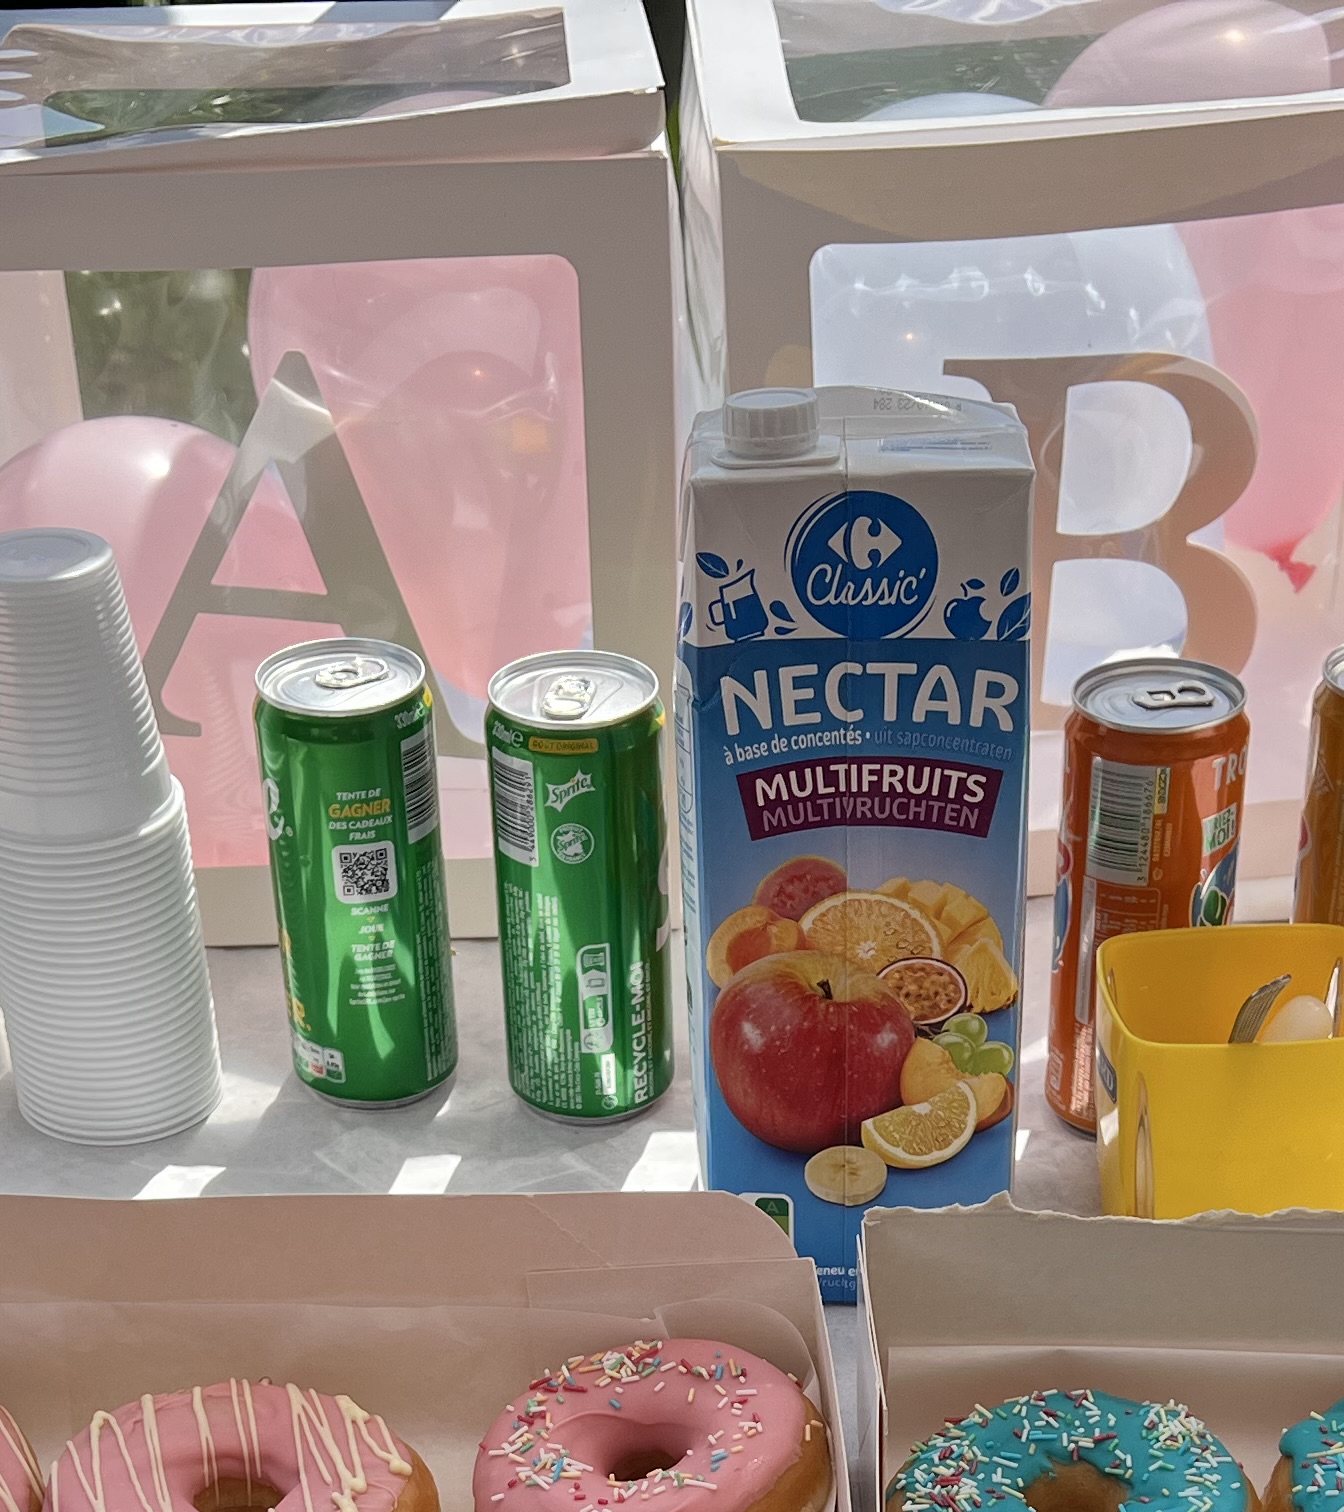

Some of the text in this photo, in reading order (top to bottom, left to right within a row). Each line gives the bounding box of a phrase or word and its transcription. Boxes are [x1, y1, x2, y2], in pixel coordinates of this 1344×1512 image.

[719, 661, 1020, 737] NECTAR
[724, 745, 733, 766] à
[735, 740, 768, 763] base
[771, 734, 788, 753] de
[336, 788, 382, 801] TENTE DE
[551, 776, 591, 804] Sprite
[755, 763, 988, 807] MULTIFRUITS
[328, 799, 392, 819] GAGNER
[328, 815, 393, 830] DES CADEAUX
[762, 796, 979, 832] MULTIVRUCHTEN
[348, 831, 376, 842] FRAIS
[629, 961, 649, 1104] RECYCLE-MOI
[766, 1200, 779, 1214] A
